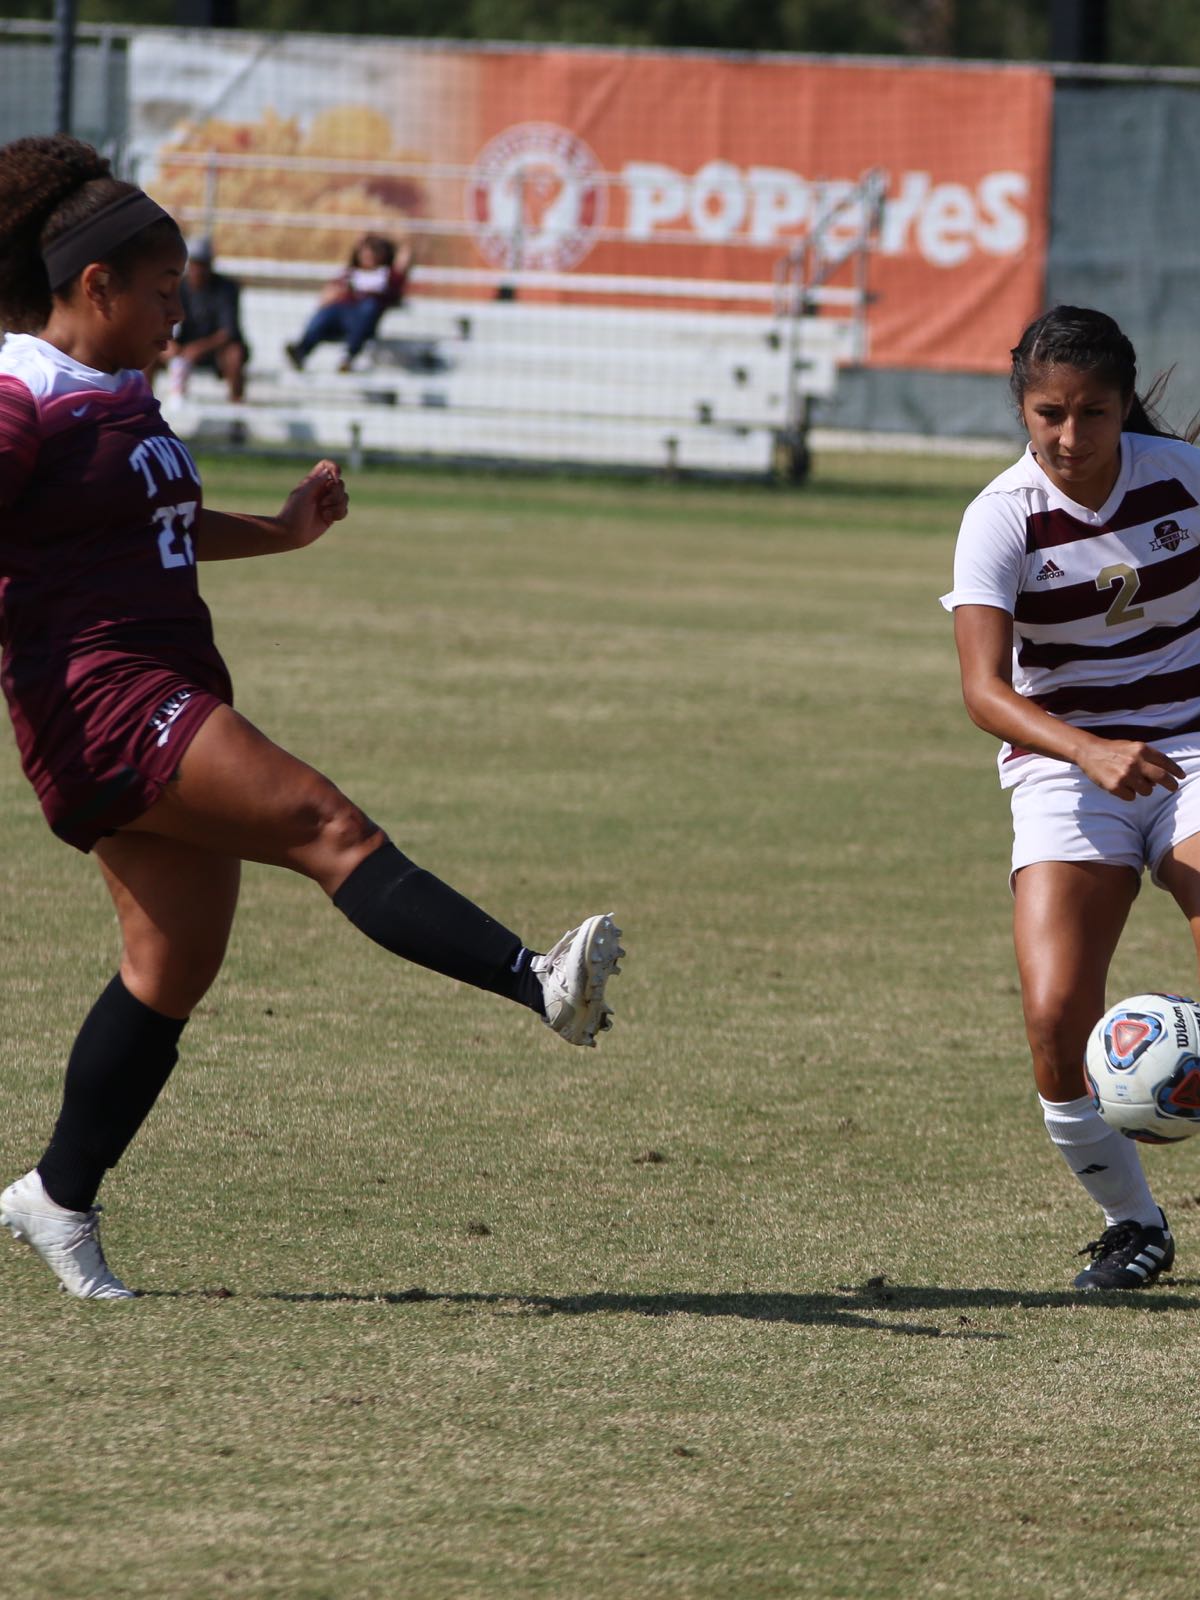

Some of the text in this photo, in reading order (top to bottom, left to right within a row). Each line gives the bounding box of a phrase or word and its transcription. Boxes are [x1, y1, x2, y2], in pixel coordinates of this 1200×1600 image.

[1036, 570, 1065, 581] adidas
[1095, 562, 1145, 627] 2
[1172, 1005, 1189, 1049] Wilson
